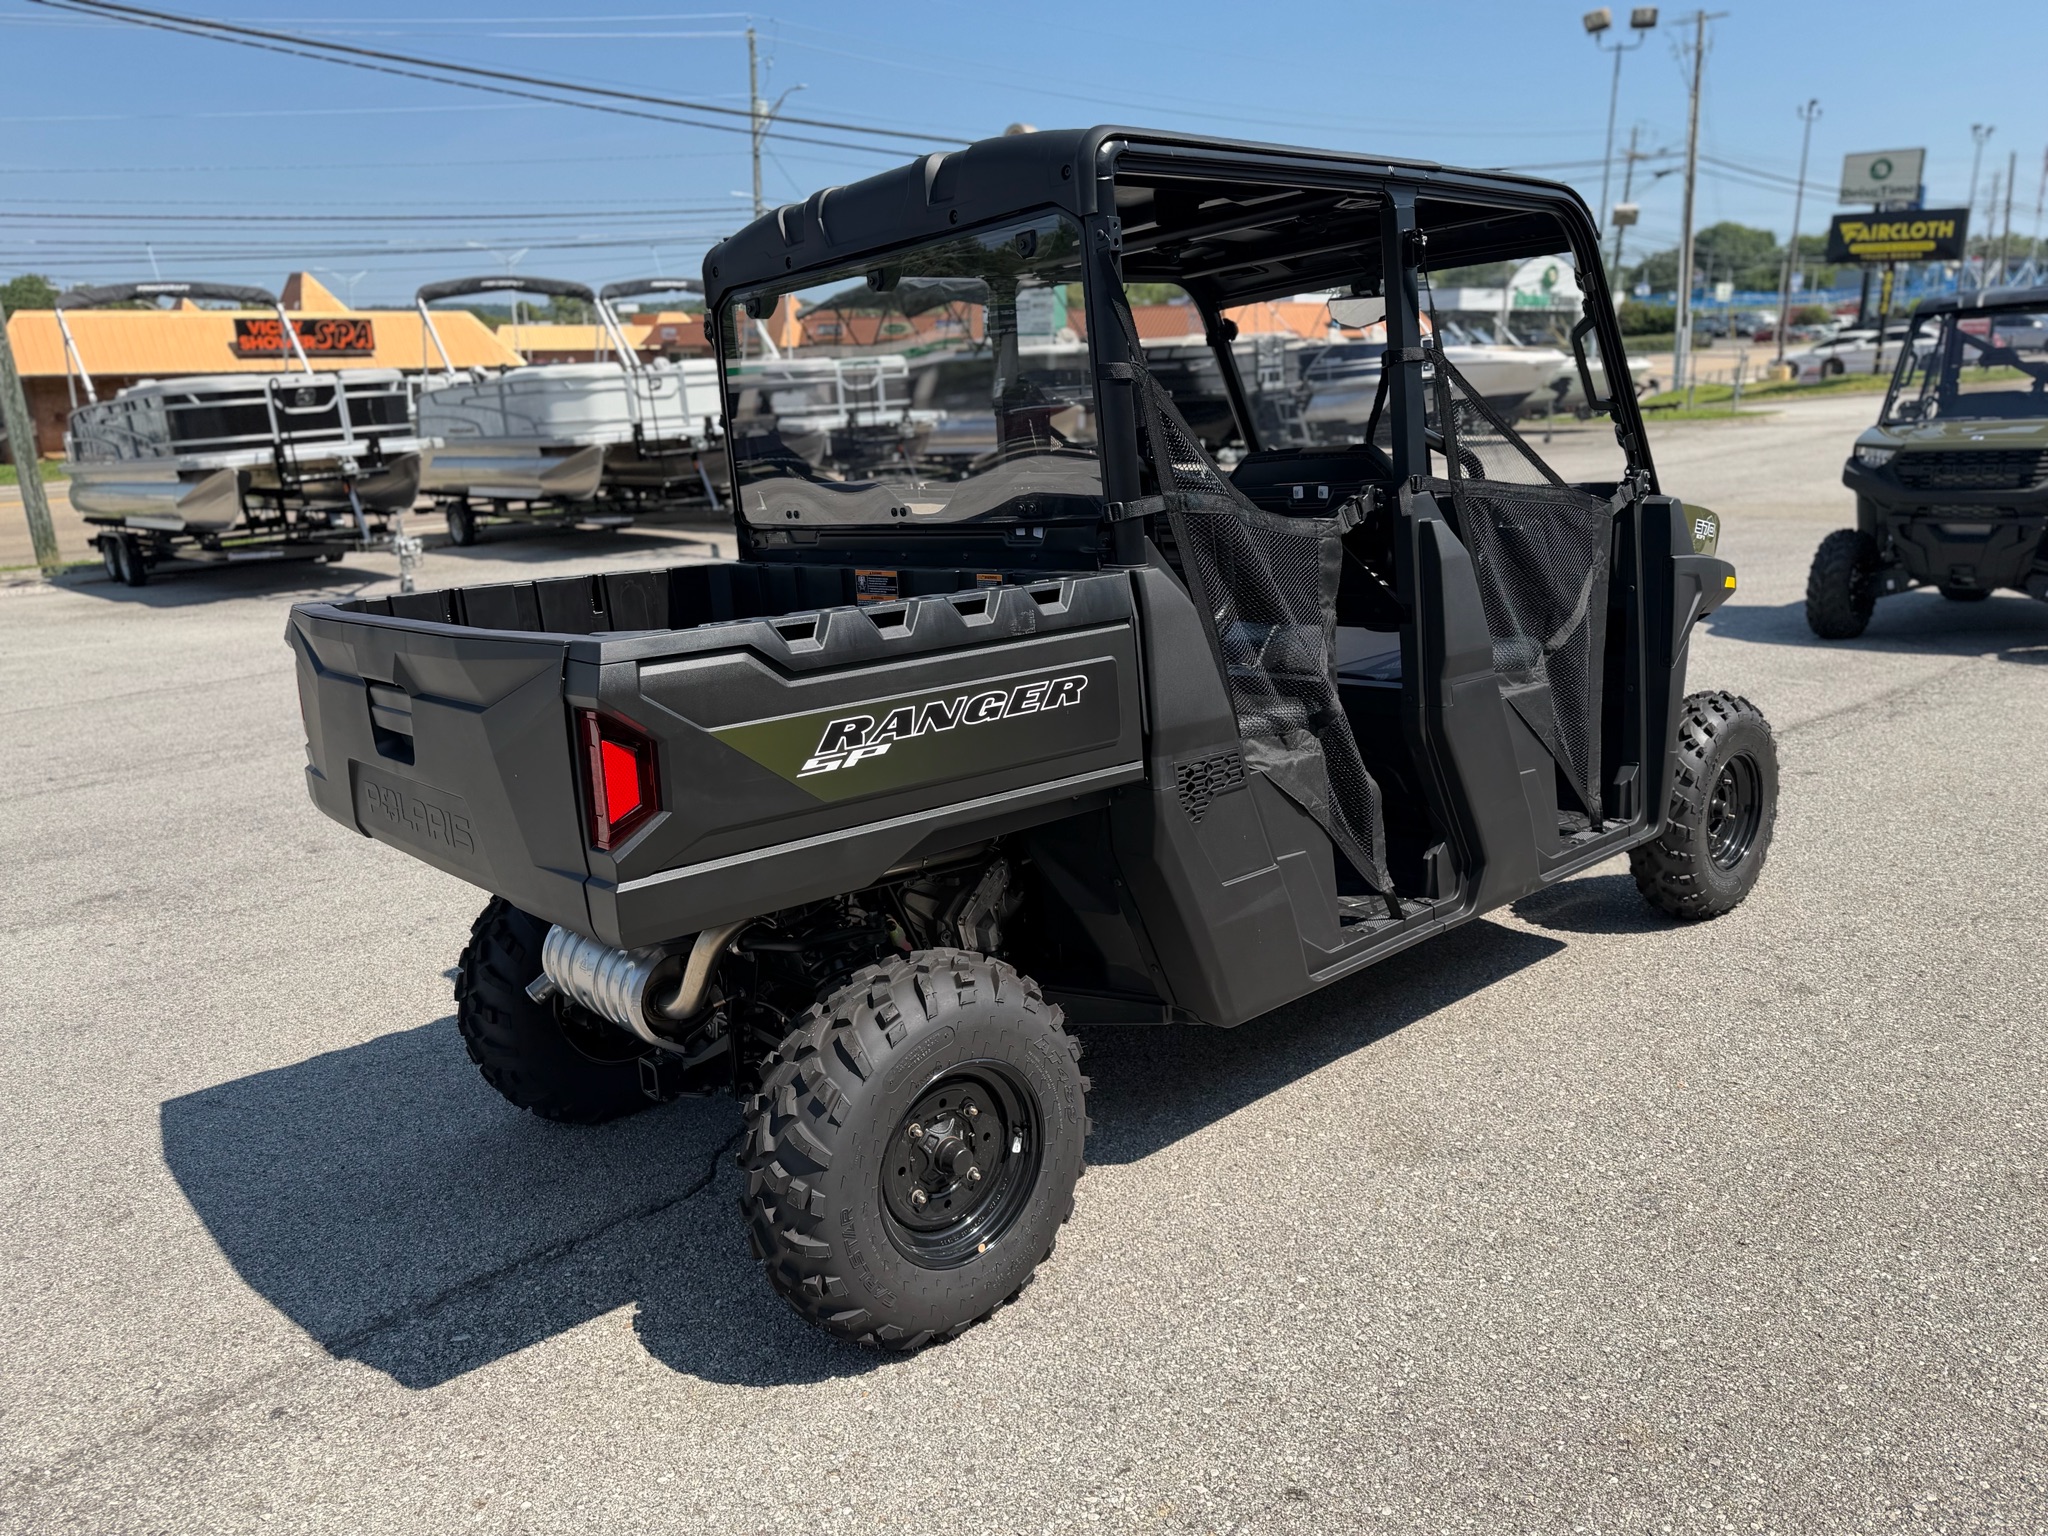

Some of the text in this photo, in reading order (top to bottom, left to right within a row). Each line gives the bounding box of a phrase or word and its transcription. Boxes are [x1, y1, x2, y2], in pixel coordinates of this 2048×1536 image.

[1839, 220, 1955, 244] FAIRCLOTH
[314, 319, 374, 349] SPA
[814, 674, 1088, 756] RANGER
[796, 743, 892, 778] SP
[363, 779, 475, 855] POLARIS
[840, 1206, 898, 1309] CARLSTAR
